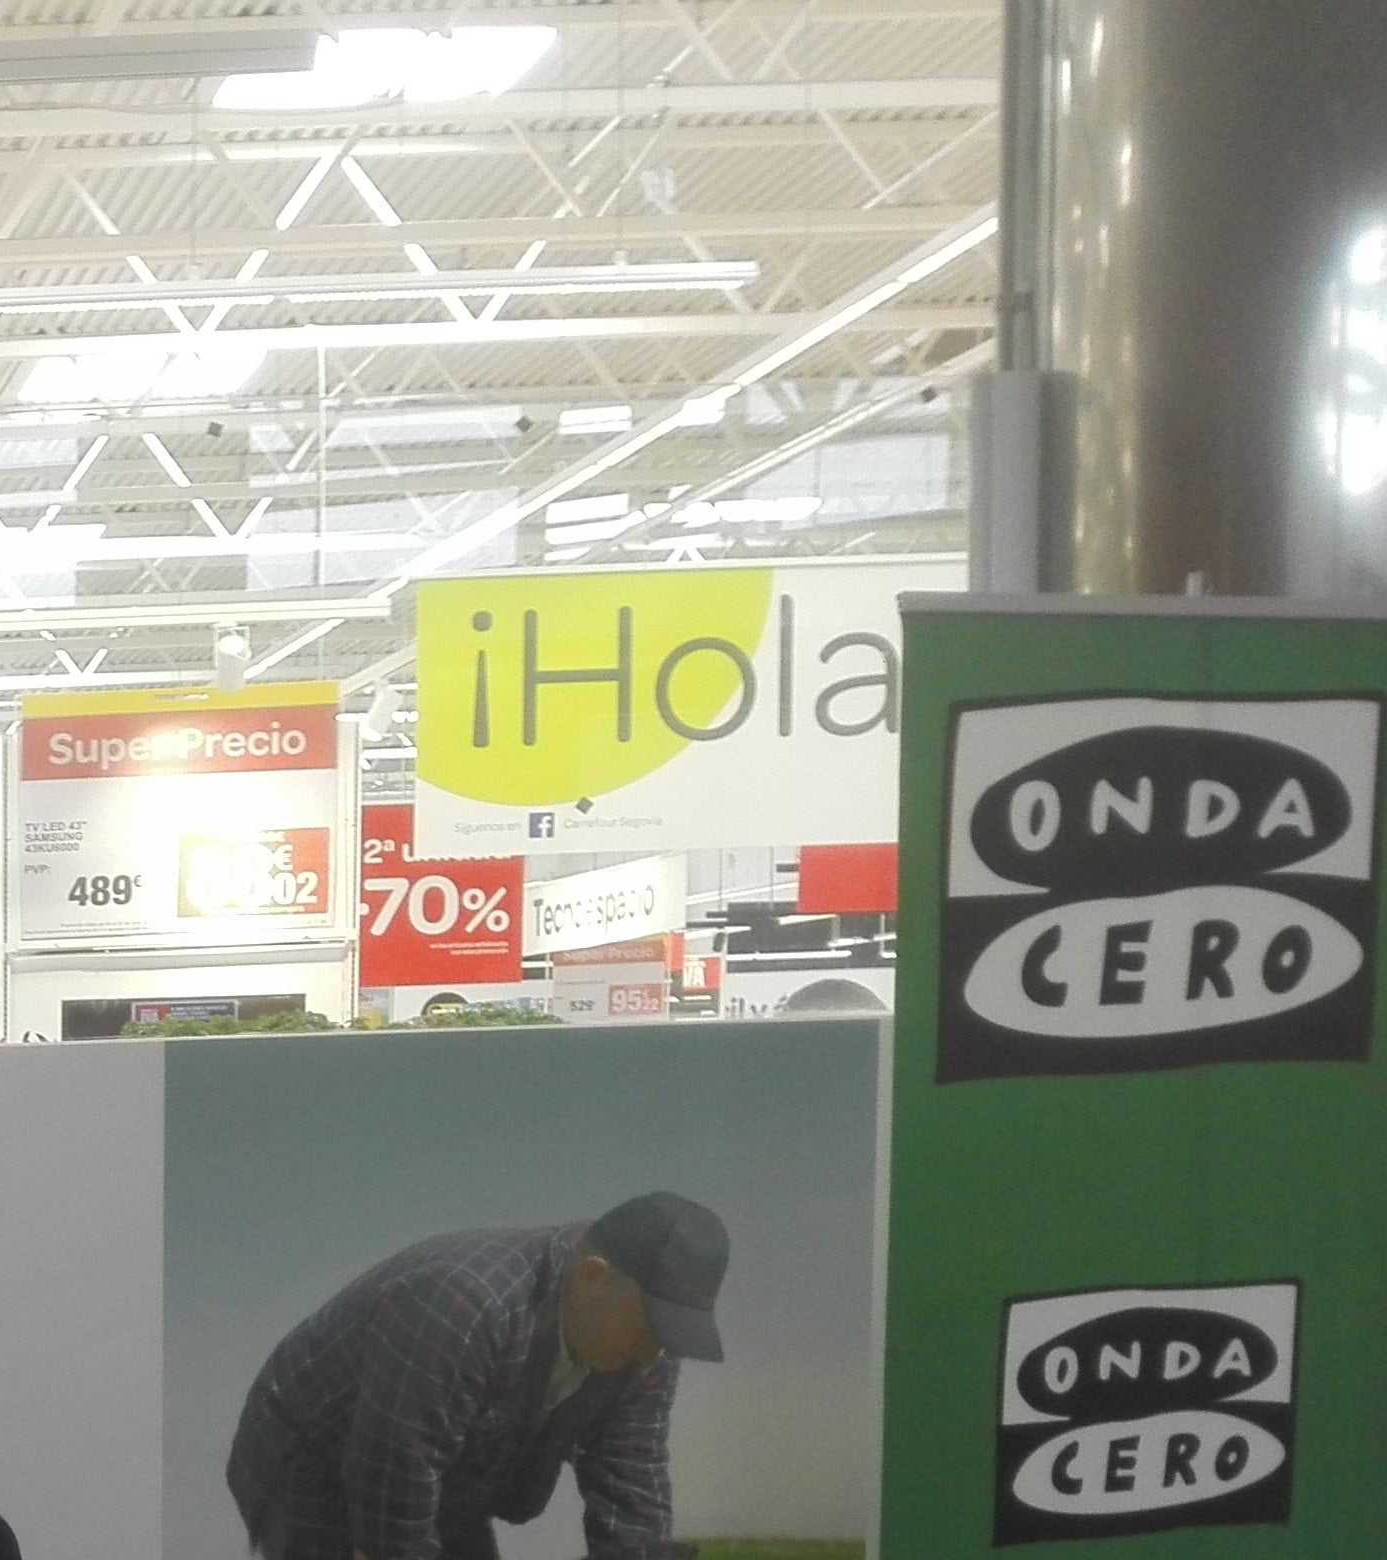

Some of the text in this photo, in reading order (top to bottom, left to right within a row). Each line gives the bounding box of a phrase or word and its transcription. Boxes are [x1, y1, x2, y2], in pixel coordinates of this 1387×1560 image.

[48, 720, 307, 771] Supe Precio
[25, 831, 84, 843] SAMSUNG
[1008, 776, 1316, 852] ONDA
[1020, 918, 1314, 1008] CERO
[1042, 1337, 1253, 1394] ONDA
[1049, 1433, 1251, 1495] CERO
